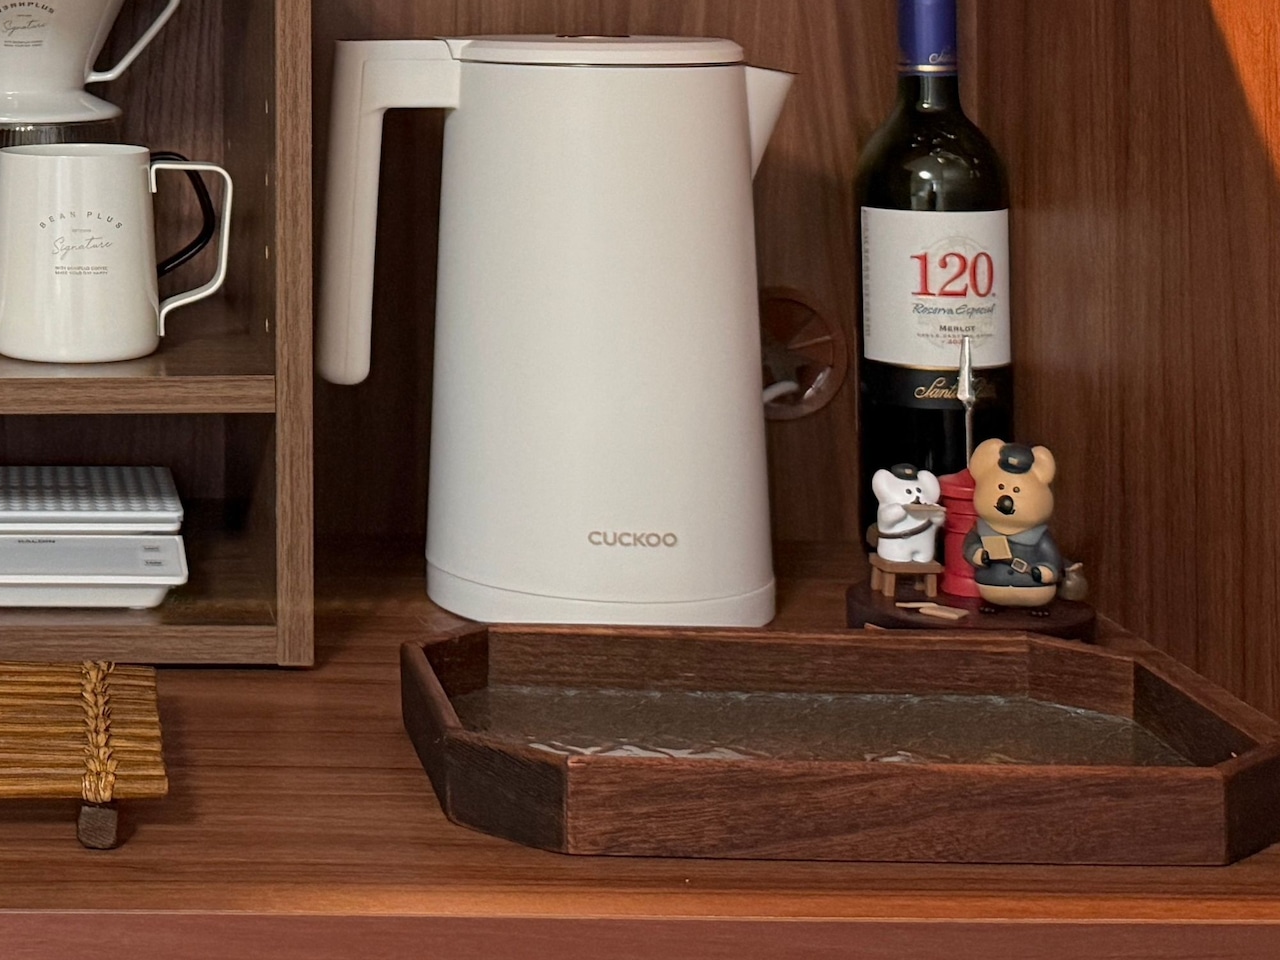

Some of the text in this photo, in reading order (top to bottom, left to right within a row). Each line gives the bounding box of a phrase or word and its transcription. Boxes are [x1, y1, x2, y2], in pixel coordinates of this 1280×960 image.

[39, 211, 123, 229] BEAN PLUS
[51, 236, 113, 260] Signature
[910, 252, 994, 298] 120
[912, 302, 997, 319] Reserva Especial
[939, 324, 977, 333] MERLOT
[913, 376, 959, 399] Sant
[587, 530, 679, 548] CUCKOO
